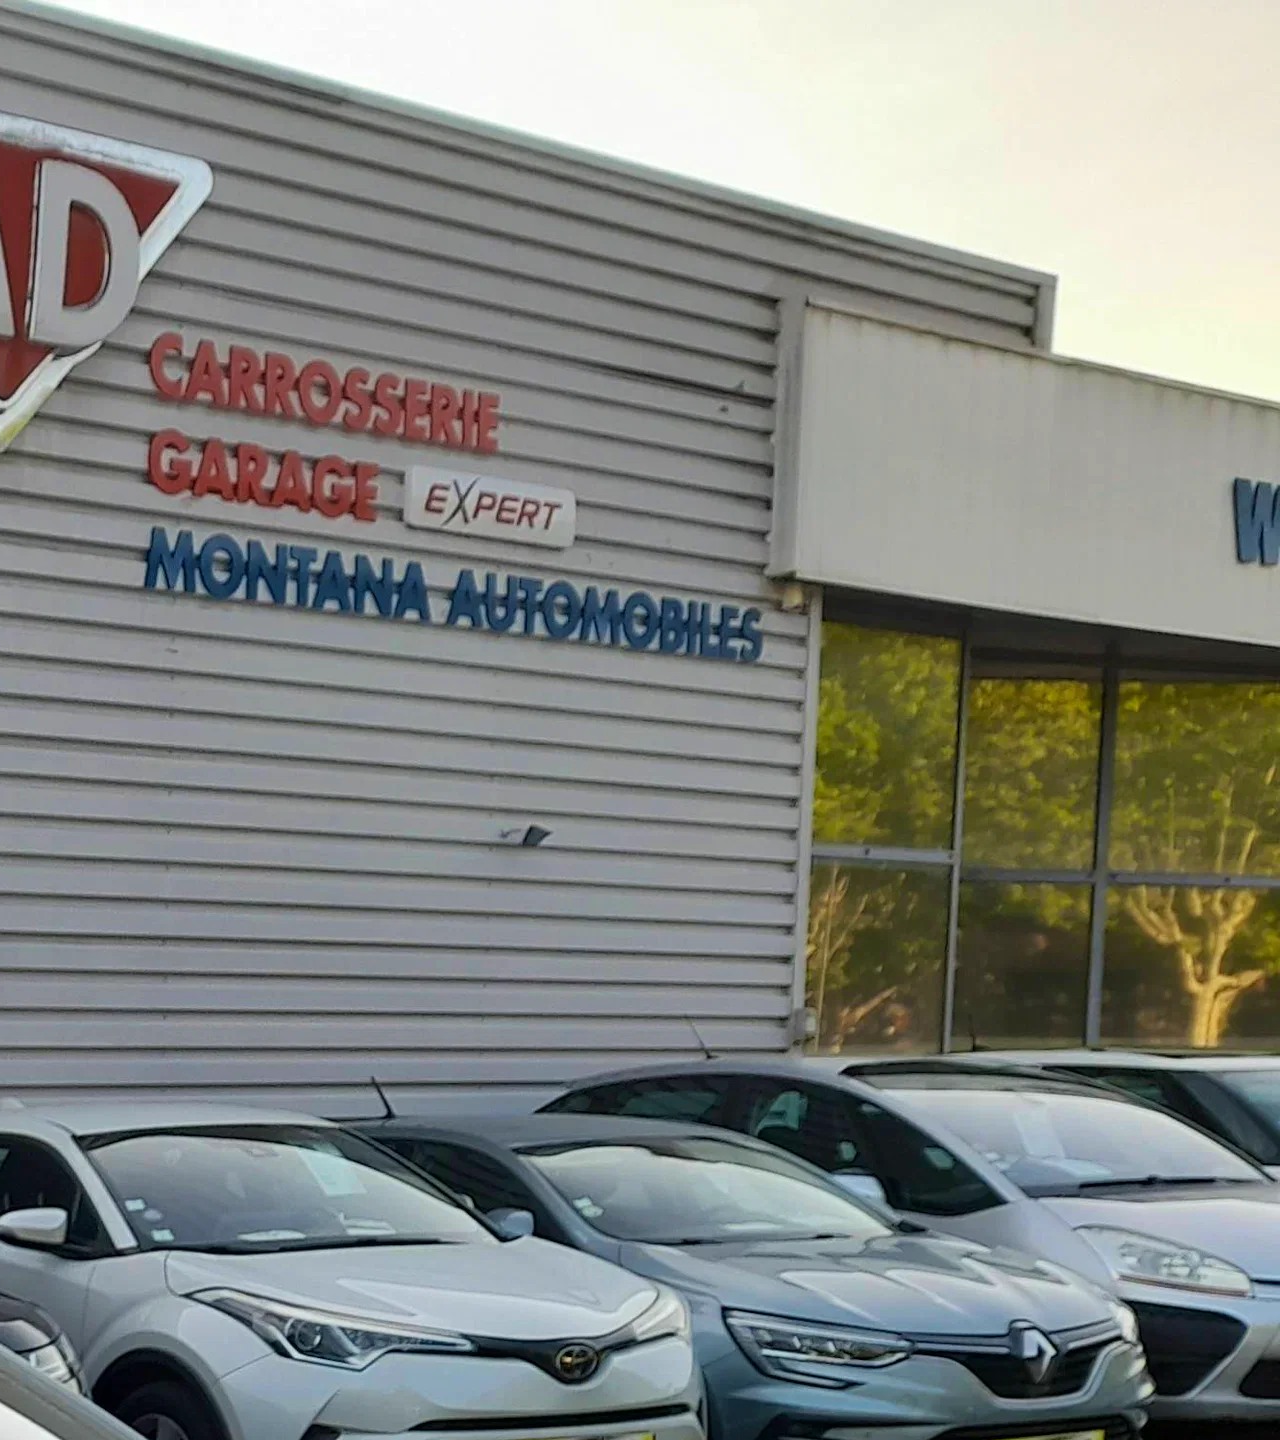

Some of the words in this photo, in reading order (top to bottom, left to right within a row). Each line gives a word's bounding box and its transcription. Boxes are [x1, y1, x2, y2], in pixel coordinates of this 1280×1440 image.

[149, 331, 501, 455] CARROSSERIE
[148, 428, 381, 523] GARAGE
[144, 526, 431, 624] MONTANA
[445, 569, 764, 664] AUTOMOBILES
